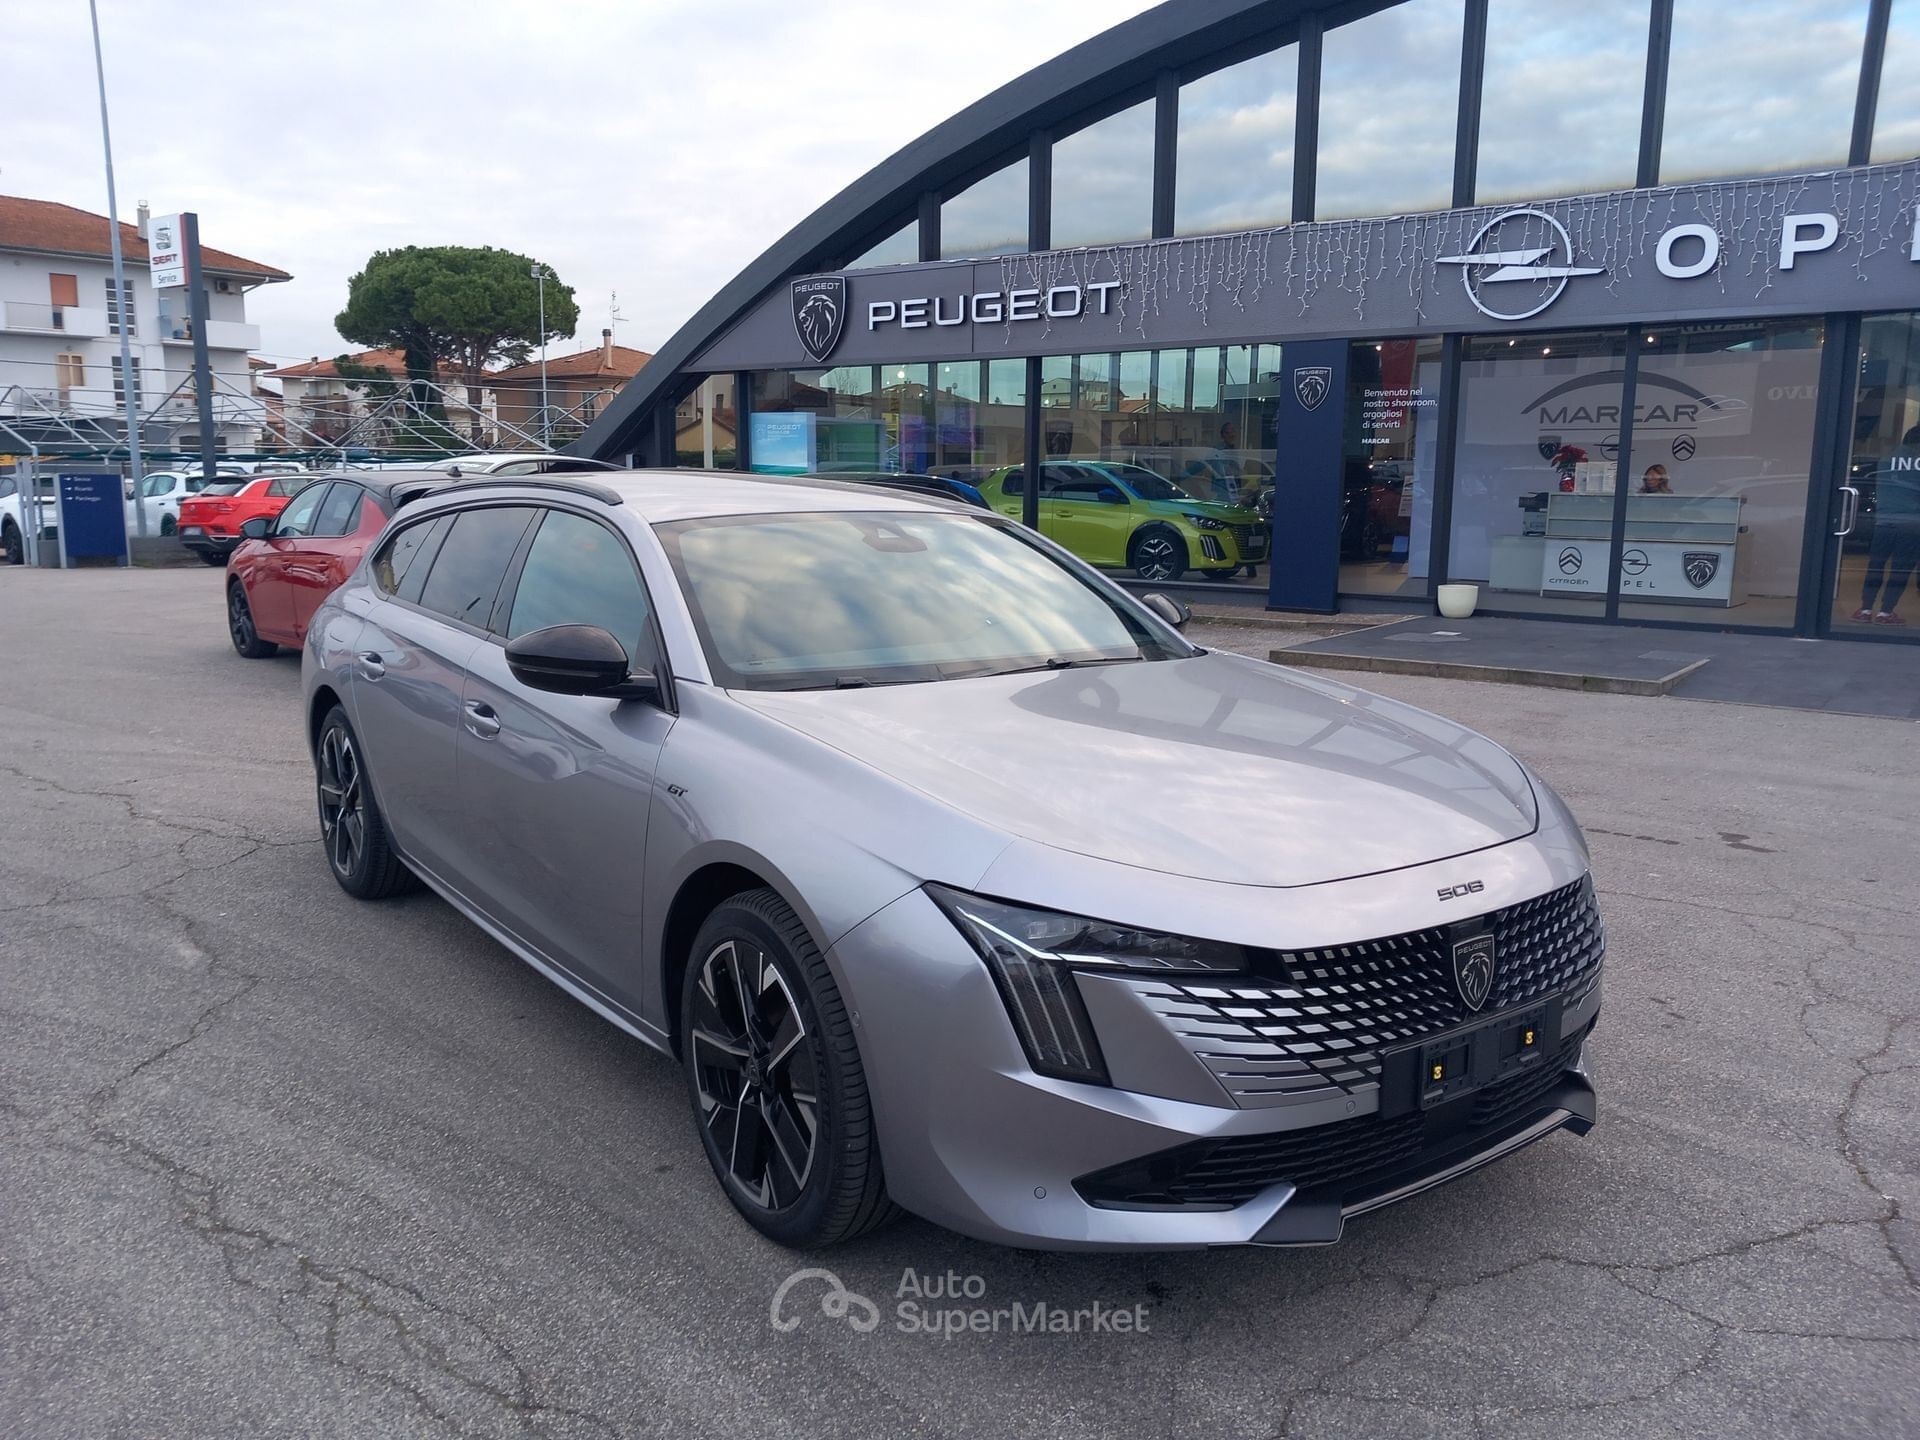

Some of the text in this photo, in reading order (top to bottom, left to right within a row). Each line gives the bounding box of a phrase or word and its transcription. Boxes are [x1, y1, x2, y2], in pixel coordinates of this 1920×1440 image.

[1655, 203, 1920, 279] OP
[152, 253, 178, 265] SEAT
[158, 273, 177, 284] Service
[794, 282, 841, 293] PEUGEOT
[868, 281, 1121, 331] PEUGEOT
[1364, 387, 1423, 397] Benvenuto nel
[1363, 399, 1390, 408] nostro
[1362, 409, 1403, 420] orgogliosi
[1362, 420, 1401, 429] di servirti
[667, 783, 689, 797] GT
[1437, 879, 1485, 902] 508
[1457, 940, 1493, 956] PEUGEOT
